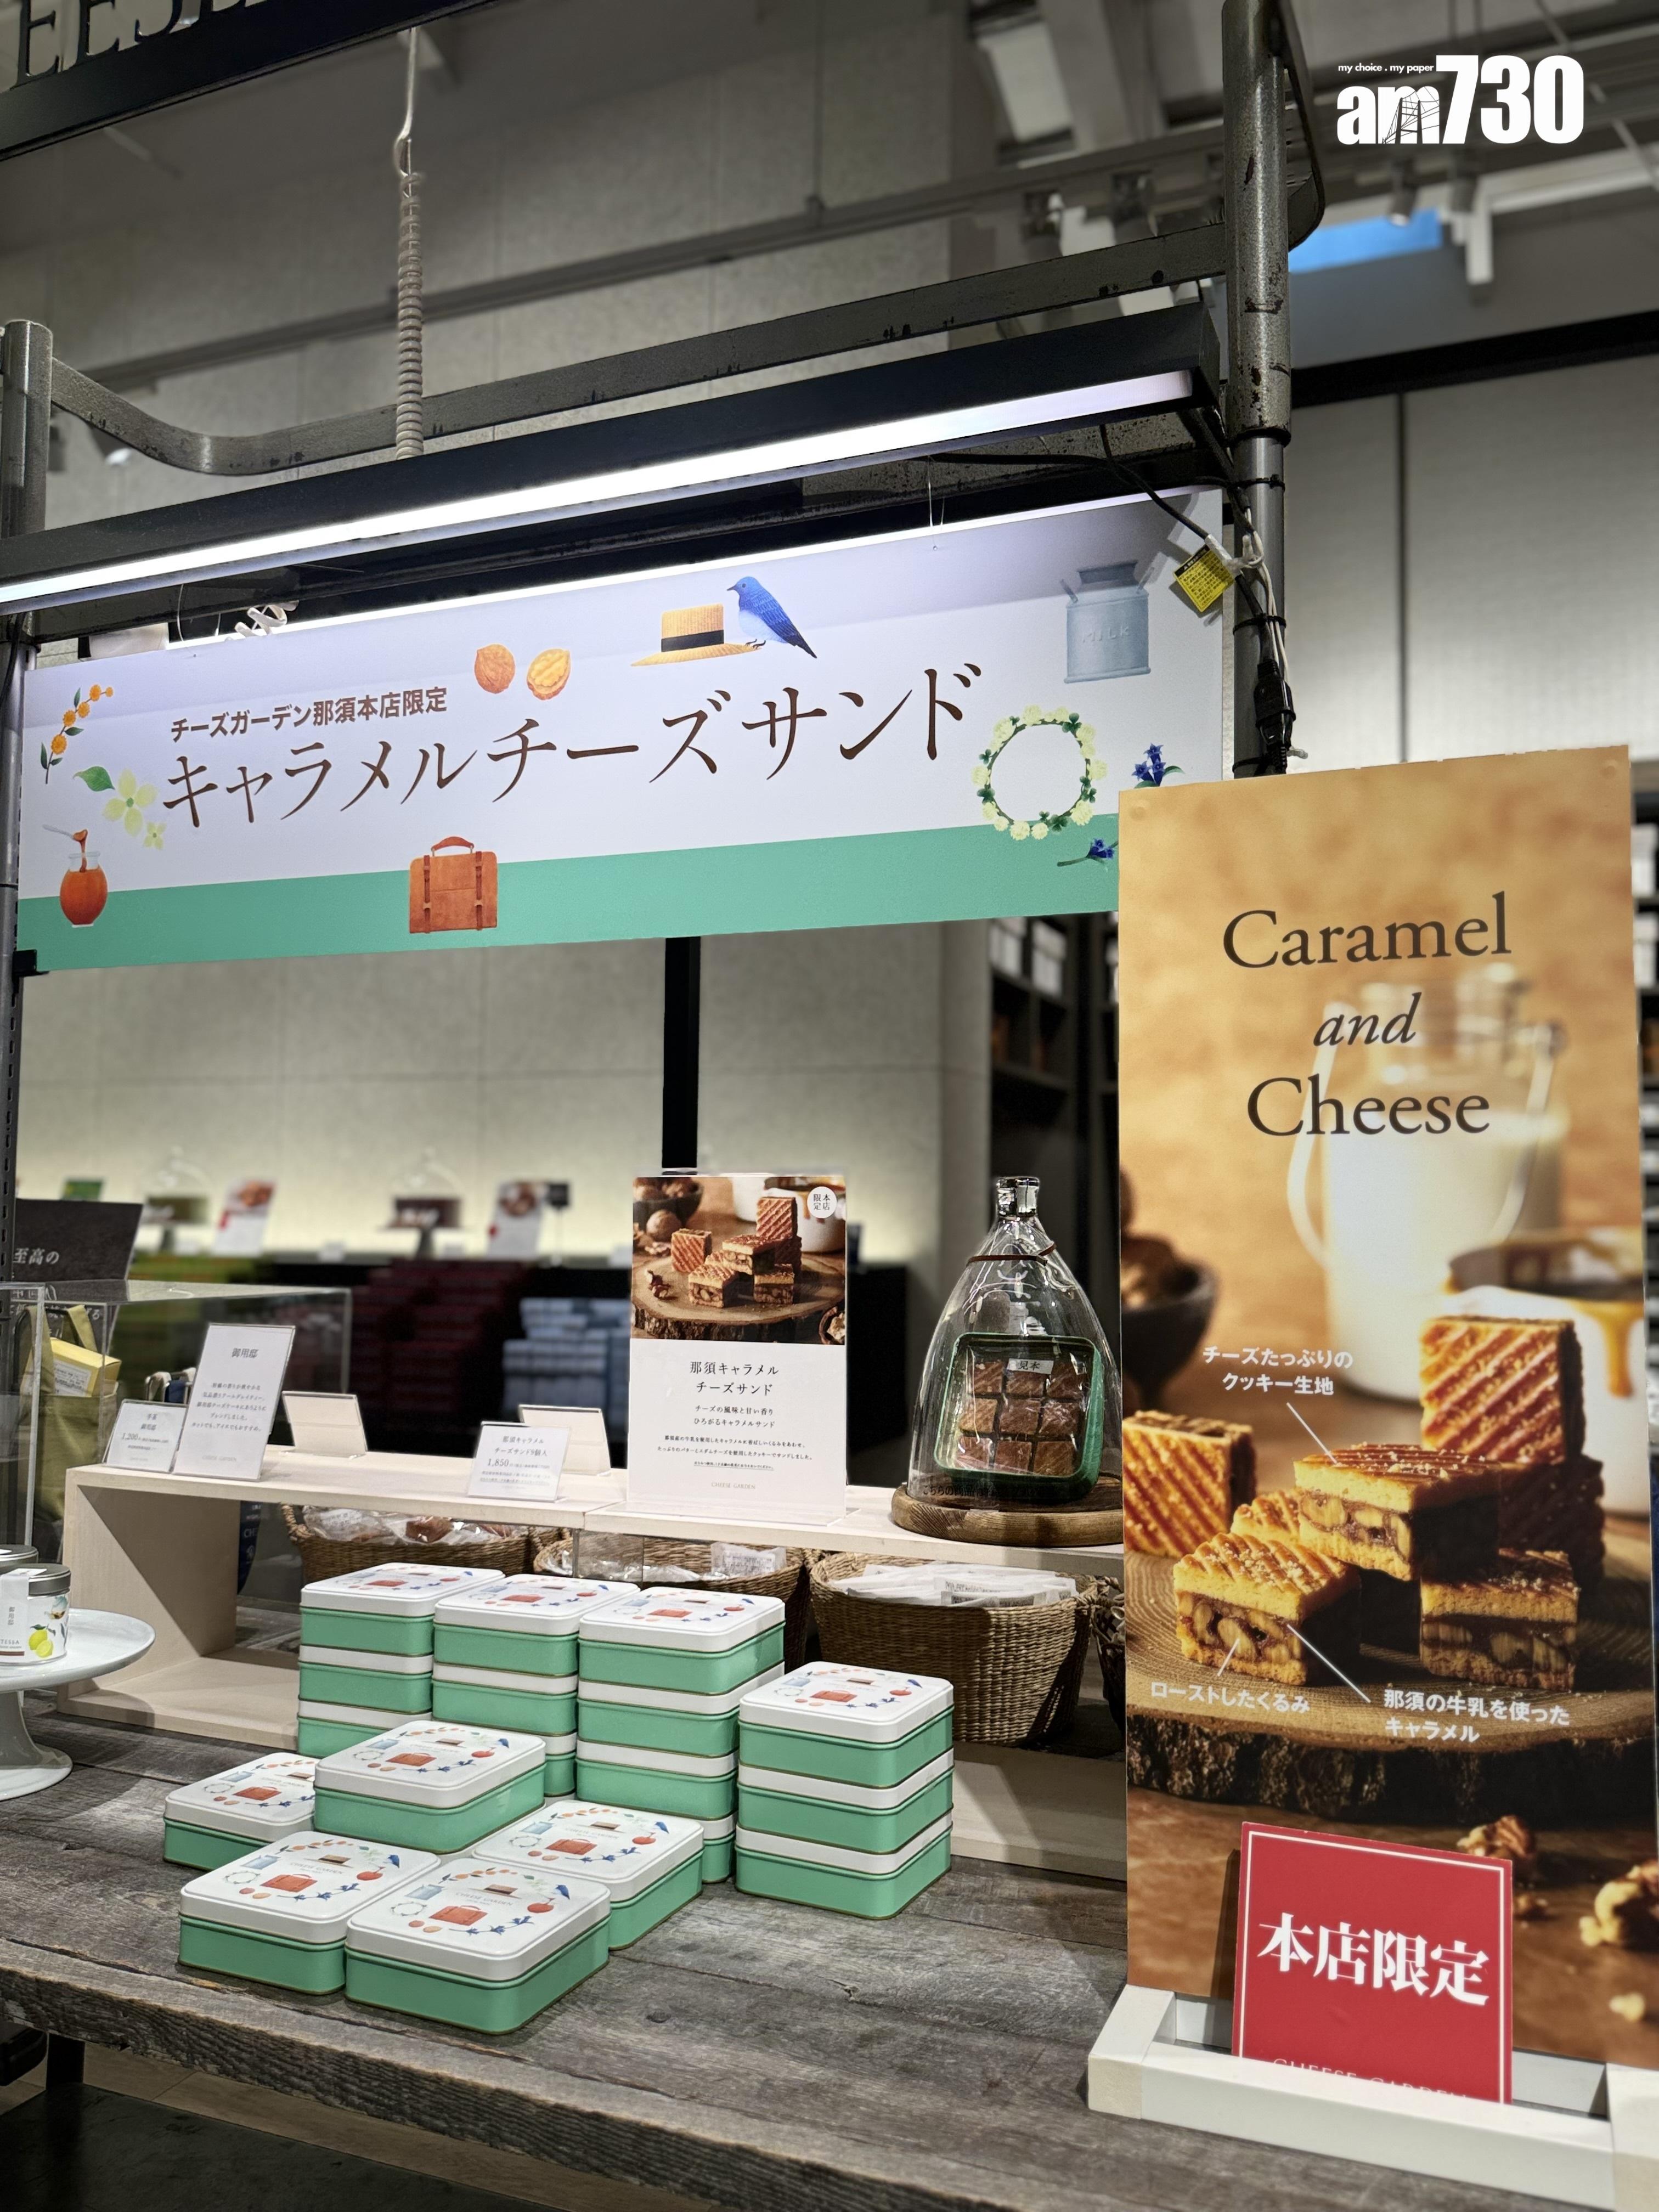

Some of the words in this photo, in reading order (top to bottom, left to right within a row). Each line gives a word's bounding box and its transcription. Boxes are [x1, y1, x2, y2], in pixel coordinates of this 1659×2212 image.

[172, 687, 447, 742] チーズガーデン那須本店限定
[163, 663, 981, 828] キャラメルチーズサンド
[1223, 891, 1512, 968] Caramel
[1313, 992, 1423, 1046] and
[1247, 1073, 1490, 1137] Cheese
[13, 1248, 60, 1265] 至高の
[689, 1361, 780, 1375] 那須キャラメル
[1018, 1361, 1041, 1370] 見本
[1203, 1345, 1353, 1370] チーズたっぷりの
[696, 1381, 774, 1396] チーズサンド
[1222, 1373, 1335, 1397] クッキー生地
[693, 1418, 776, 1428] ひろがるキャラメルサンド
[695, 1405, 774, 1415] チーズの風味と甘い香り
[487, 1458, 509, 1468] 1,850
[1151, 1681, 1310, 1714] ローストしたくるみ
[1384, 1689, 1571, 1727] 那須の牛乳を使った
[1385, 1717, 1480, 1744] キャラメル
[1256, 1912, 1490, 2007] 本店限定
